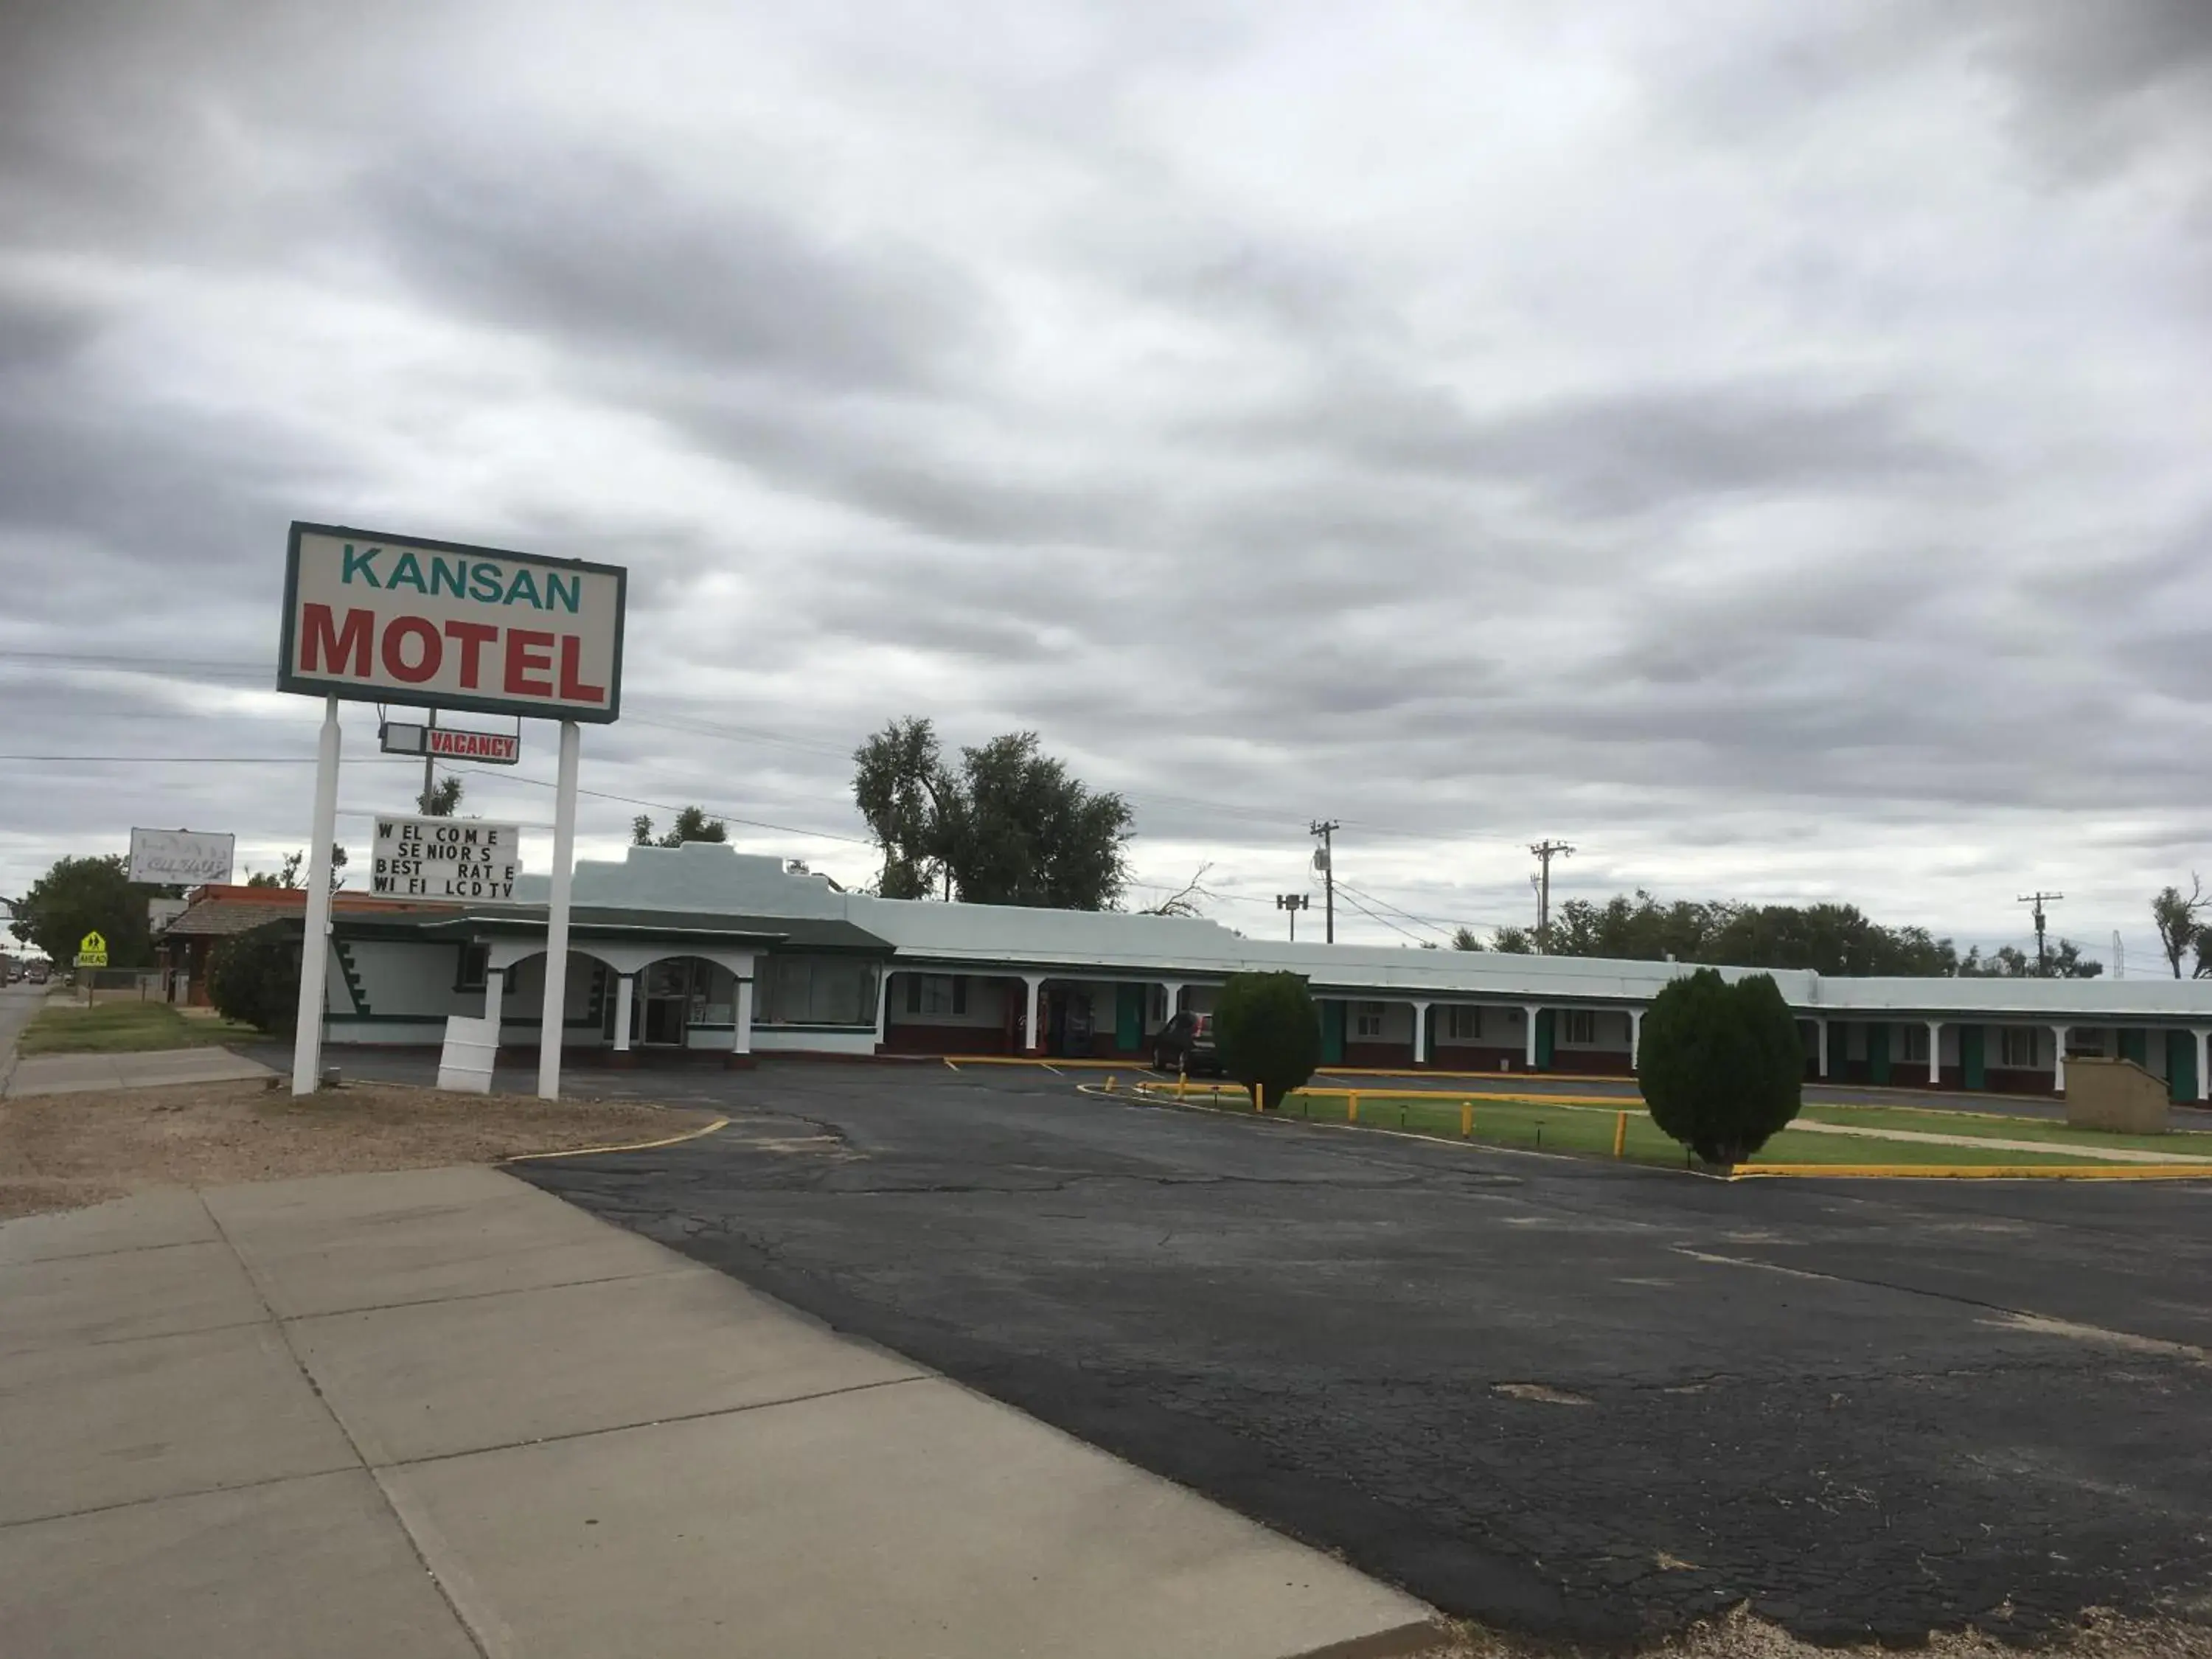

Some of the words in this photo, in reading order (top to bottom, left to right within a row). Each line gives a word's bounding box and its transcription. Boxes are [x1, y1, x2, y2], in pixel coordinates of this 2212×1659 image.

[341, 544, 580, 613] KANSAN
[299, 603, 605, 703] MOTEL
[431, 732, 514, 757] VACANCY
[398, 843, 491, 862] SENIORS
[375, 859, 422, 875] BEST
[458, 863, 515, 880] RATE
